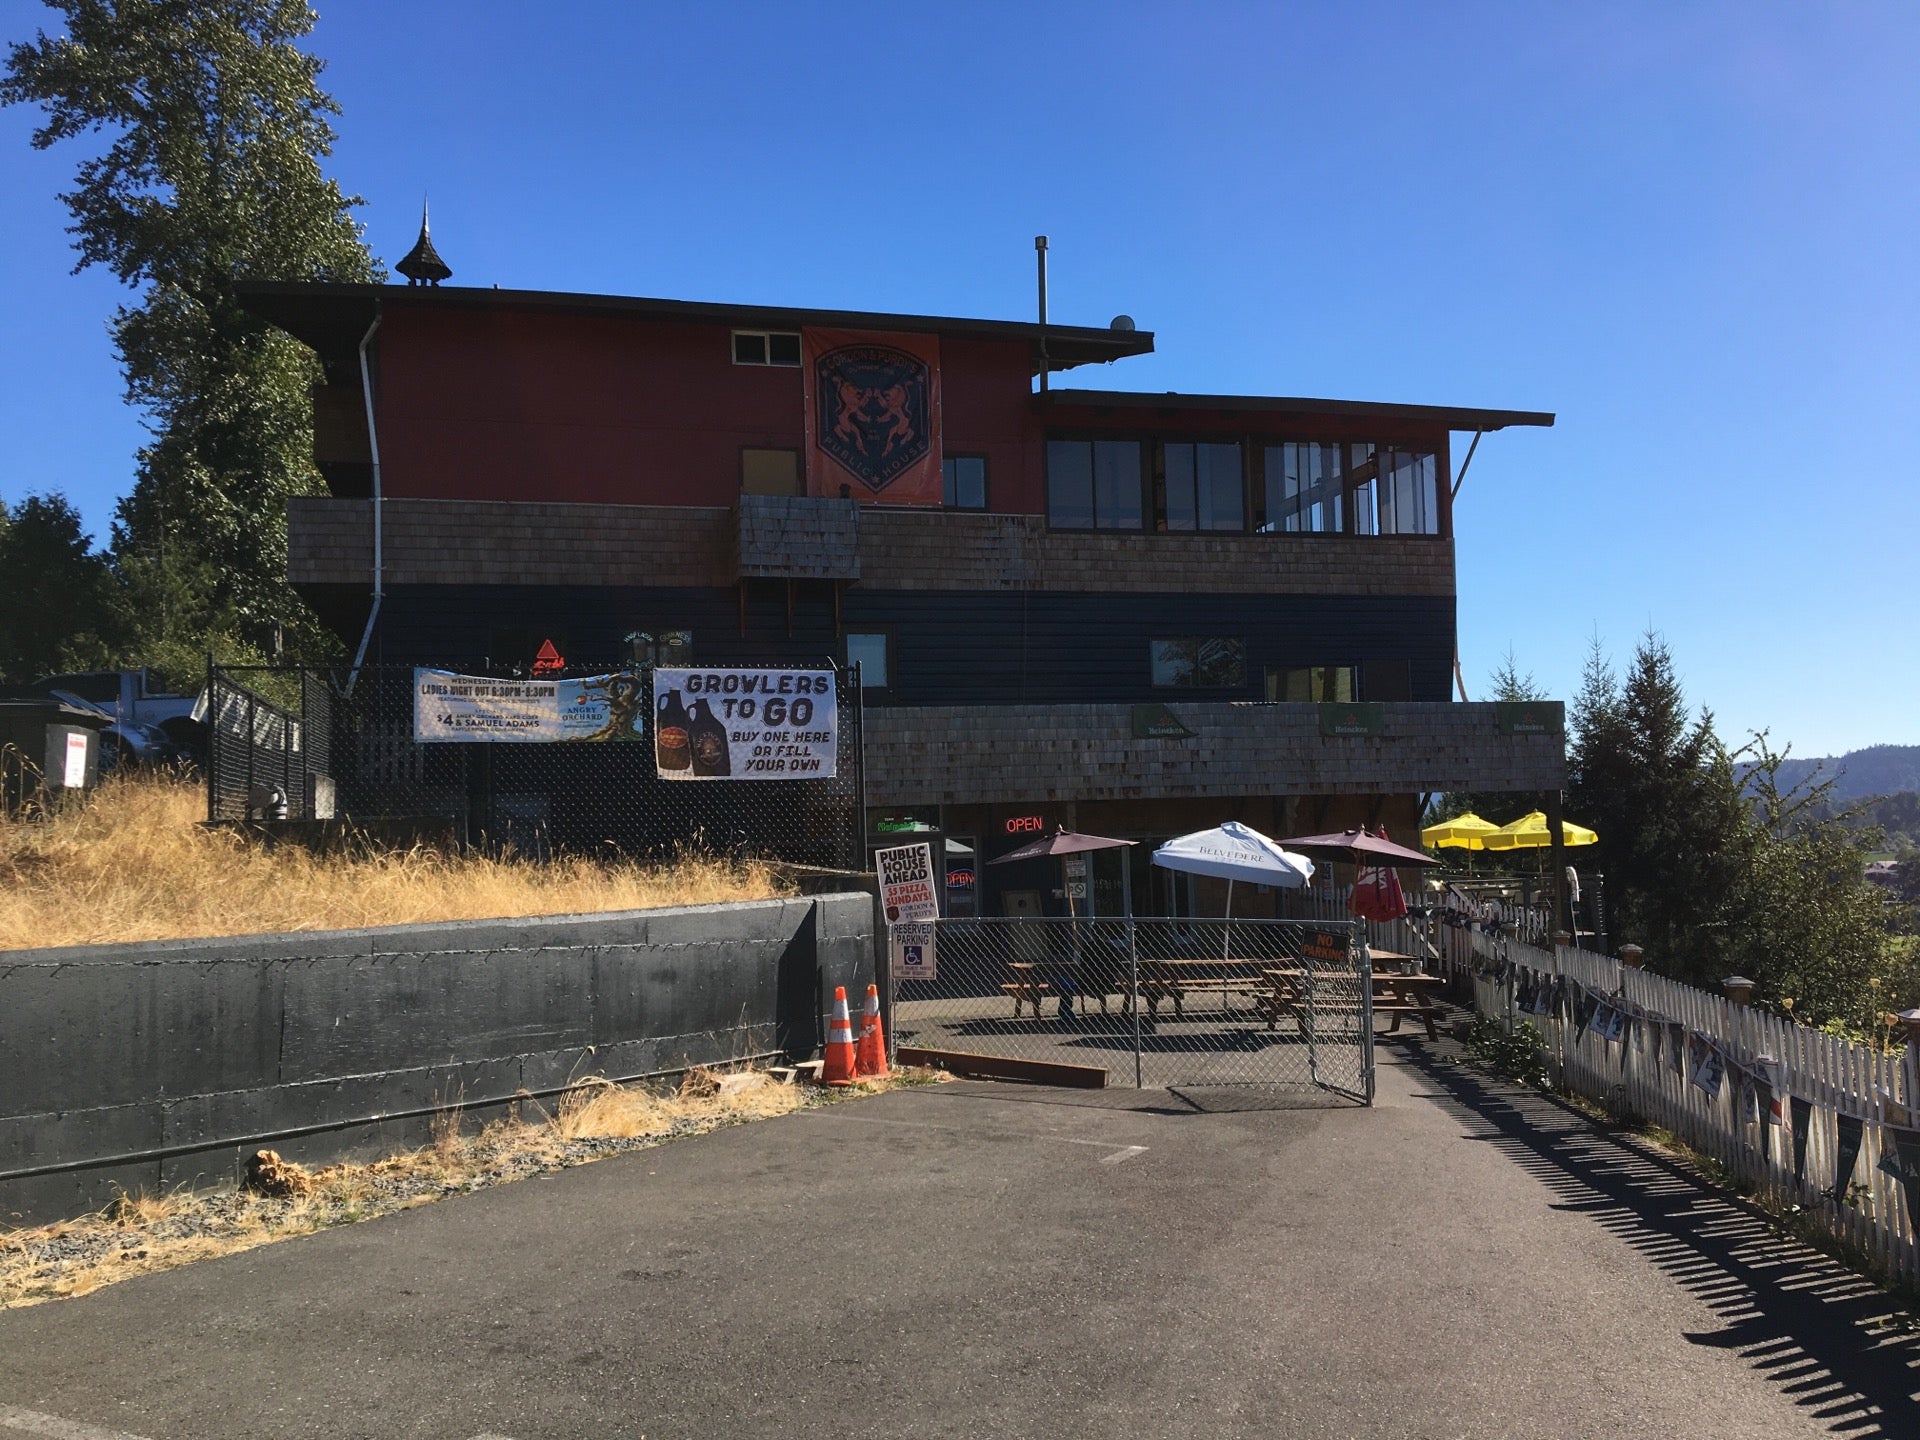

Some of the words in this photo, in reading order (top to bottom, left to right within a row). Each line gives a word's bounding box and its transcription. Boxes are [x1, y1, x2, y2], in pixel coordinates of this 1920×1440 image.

[824, 436, 871, 476] PUBLIC
[882, 440, 926, 478] HOUSE
[451, 678, 496, 686] WEDNESDAY
[685, 674, 829, 694] GROWLERS
[422, 684, 448, 695] LADIES
[450, 685, 473, 696] NIGHT
[475, 686, 489, 697] OUT
[567, 706, 597, 714] ANGRY
[723, 698, 756, 719] TO
[762, 697, 814, 727] GO
[437, 714, 454, 727] $4
[455, 719, 462, 727] &
[465, 719, 505, 727] SAMUEL
[506, 720, 540, 728] ADAMS
[1148, 727, 1184, 735] Heineken
[1335, 725, 1369, 733] Heineken
[731, 731, 760, 742] BUY
[763, 731, 790, 743] ONE
[793, 731, 830, 743] HERE
[753, 745, 772, 756] OR
[775, 745, 812, 756] FILL
[745, 759, 785, 771] YOUR
[789, 759, 820, 771] OWN
[1006, 816, 1043, 832] OPEN
[879, 846, 926, 863] PUBLIC
[1199, 846, 1265, 863] BELVEDERE
[882, 857, 926, 874] HOUSE
[884, 869, 928, 885] AHEAD
[945, 872, 975, 886] OPEN
[888, 886, 898, 897] $5
[899, 883, 928, 895] PIZZA
[886, 891, 933, 906] SUNDAYS!
[900, 903, 928, 912] GORDON
[893, 924, 932, 934] RESERVED
[896, 935, 929, 945] PARKING
[1316, 933, 1334, 946] NO
[1302, 944, 1345, 961] PARKING
